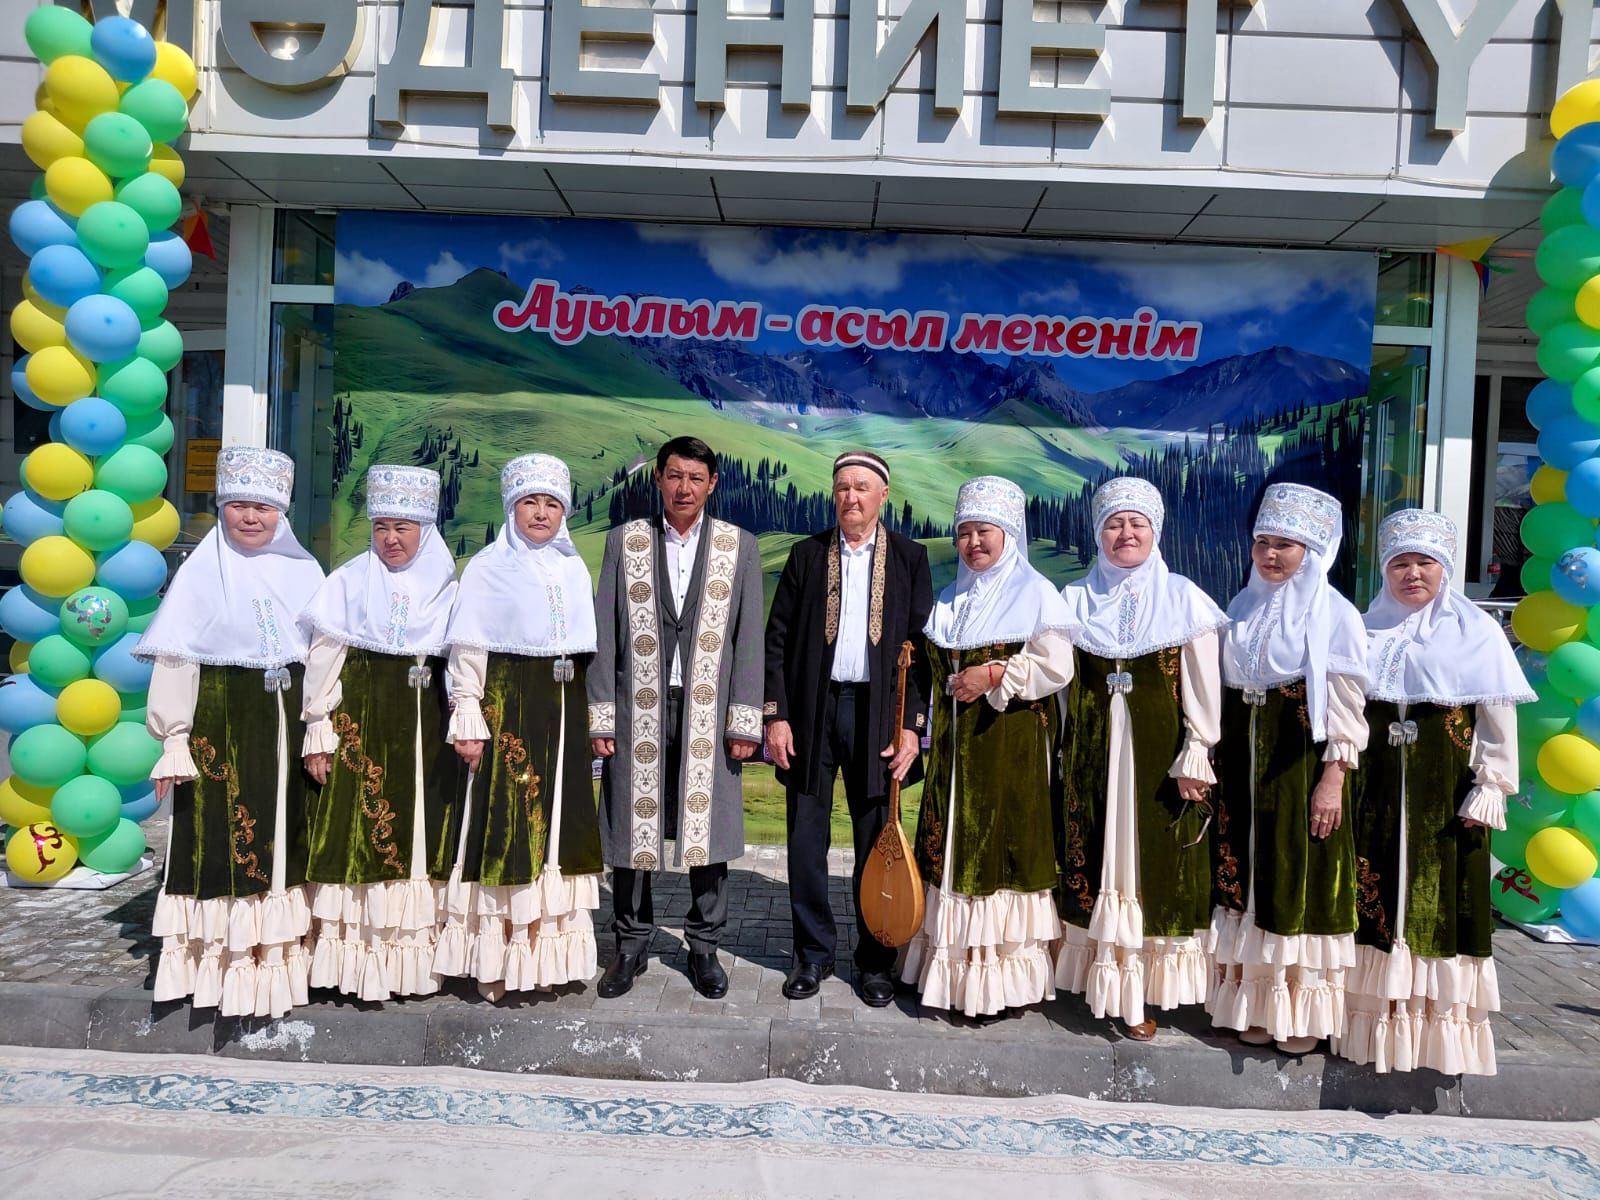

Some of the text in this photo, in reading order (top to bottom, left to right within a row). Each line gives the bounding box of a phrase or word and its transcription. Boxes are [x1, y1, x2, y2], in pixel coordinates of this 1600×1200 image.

[495, 281, 760, 343] Ауылым
[799, 309, 947, 350] асыл
[953, 310, 1200, 359] мекенім
